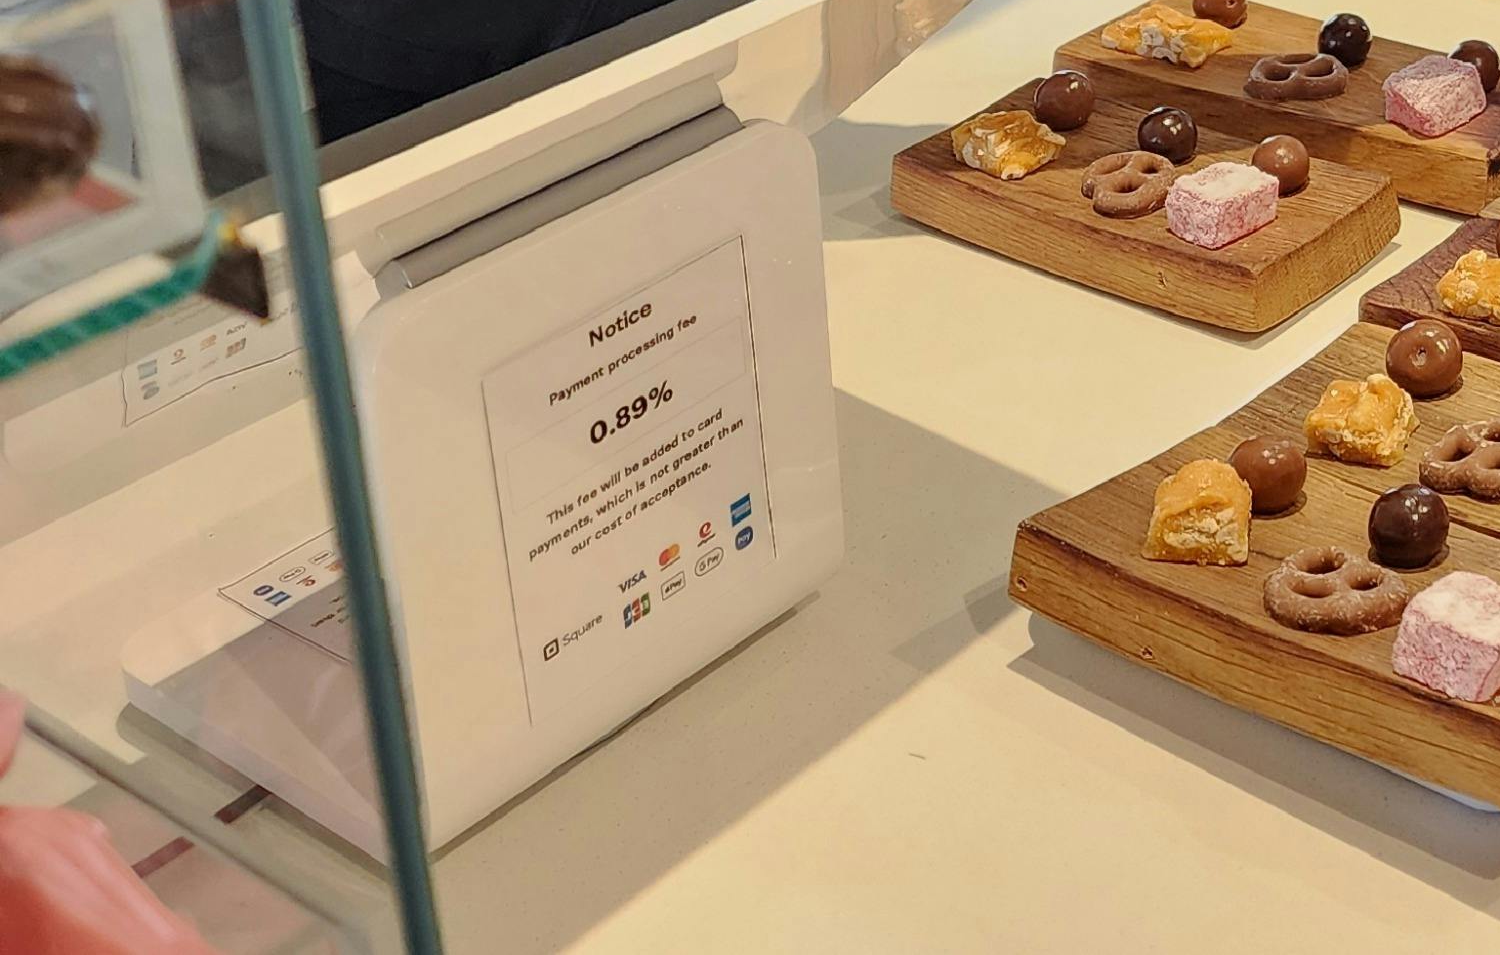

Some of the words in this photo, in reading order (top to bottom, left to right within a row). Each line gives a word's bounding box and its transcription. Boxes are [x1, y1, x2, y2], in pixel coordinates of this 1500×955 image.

[549, 366, 604, 406] Payment
[608, 327, 675, 375] processing
[677, 315, 697, 333] fee
[588, 303, 652, 348] Notice
[590, 379, 673, 444] 0.89%
[528, 515, 594, 561] payments,
[595, 488, 633, 517] which
[635, 479, 646, 492] is
[650, 465, 670, 485] not
[672, 435, 716, 471] greater
[717, 419, 744, 441] than
[546, 502, 574, 525] This
[577, 489, 598, 507] fee
[600, 471, 621, 493] will
[624, 462, 639, 477] be
[642, 435, 679, 466] added
[681, 428, 695, 442] to
[697, 408, 723, 432] card
[571, 536, 591, 556] our
[595, 516, 623, 541] cost
[625, 506, 638, 521] of
[640, 461, 712, 511] acceptance.
[618, 570, 647, 593] VISA
[562, 612, 604, 647] Square
